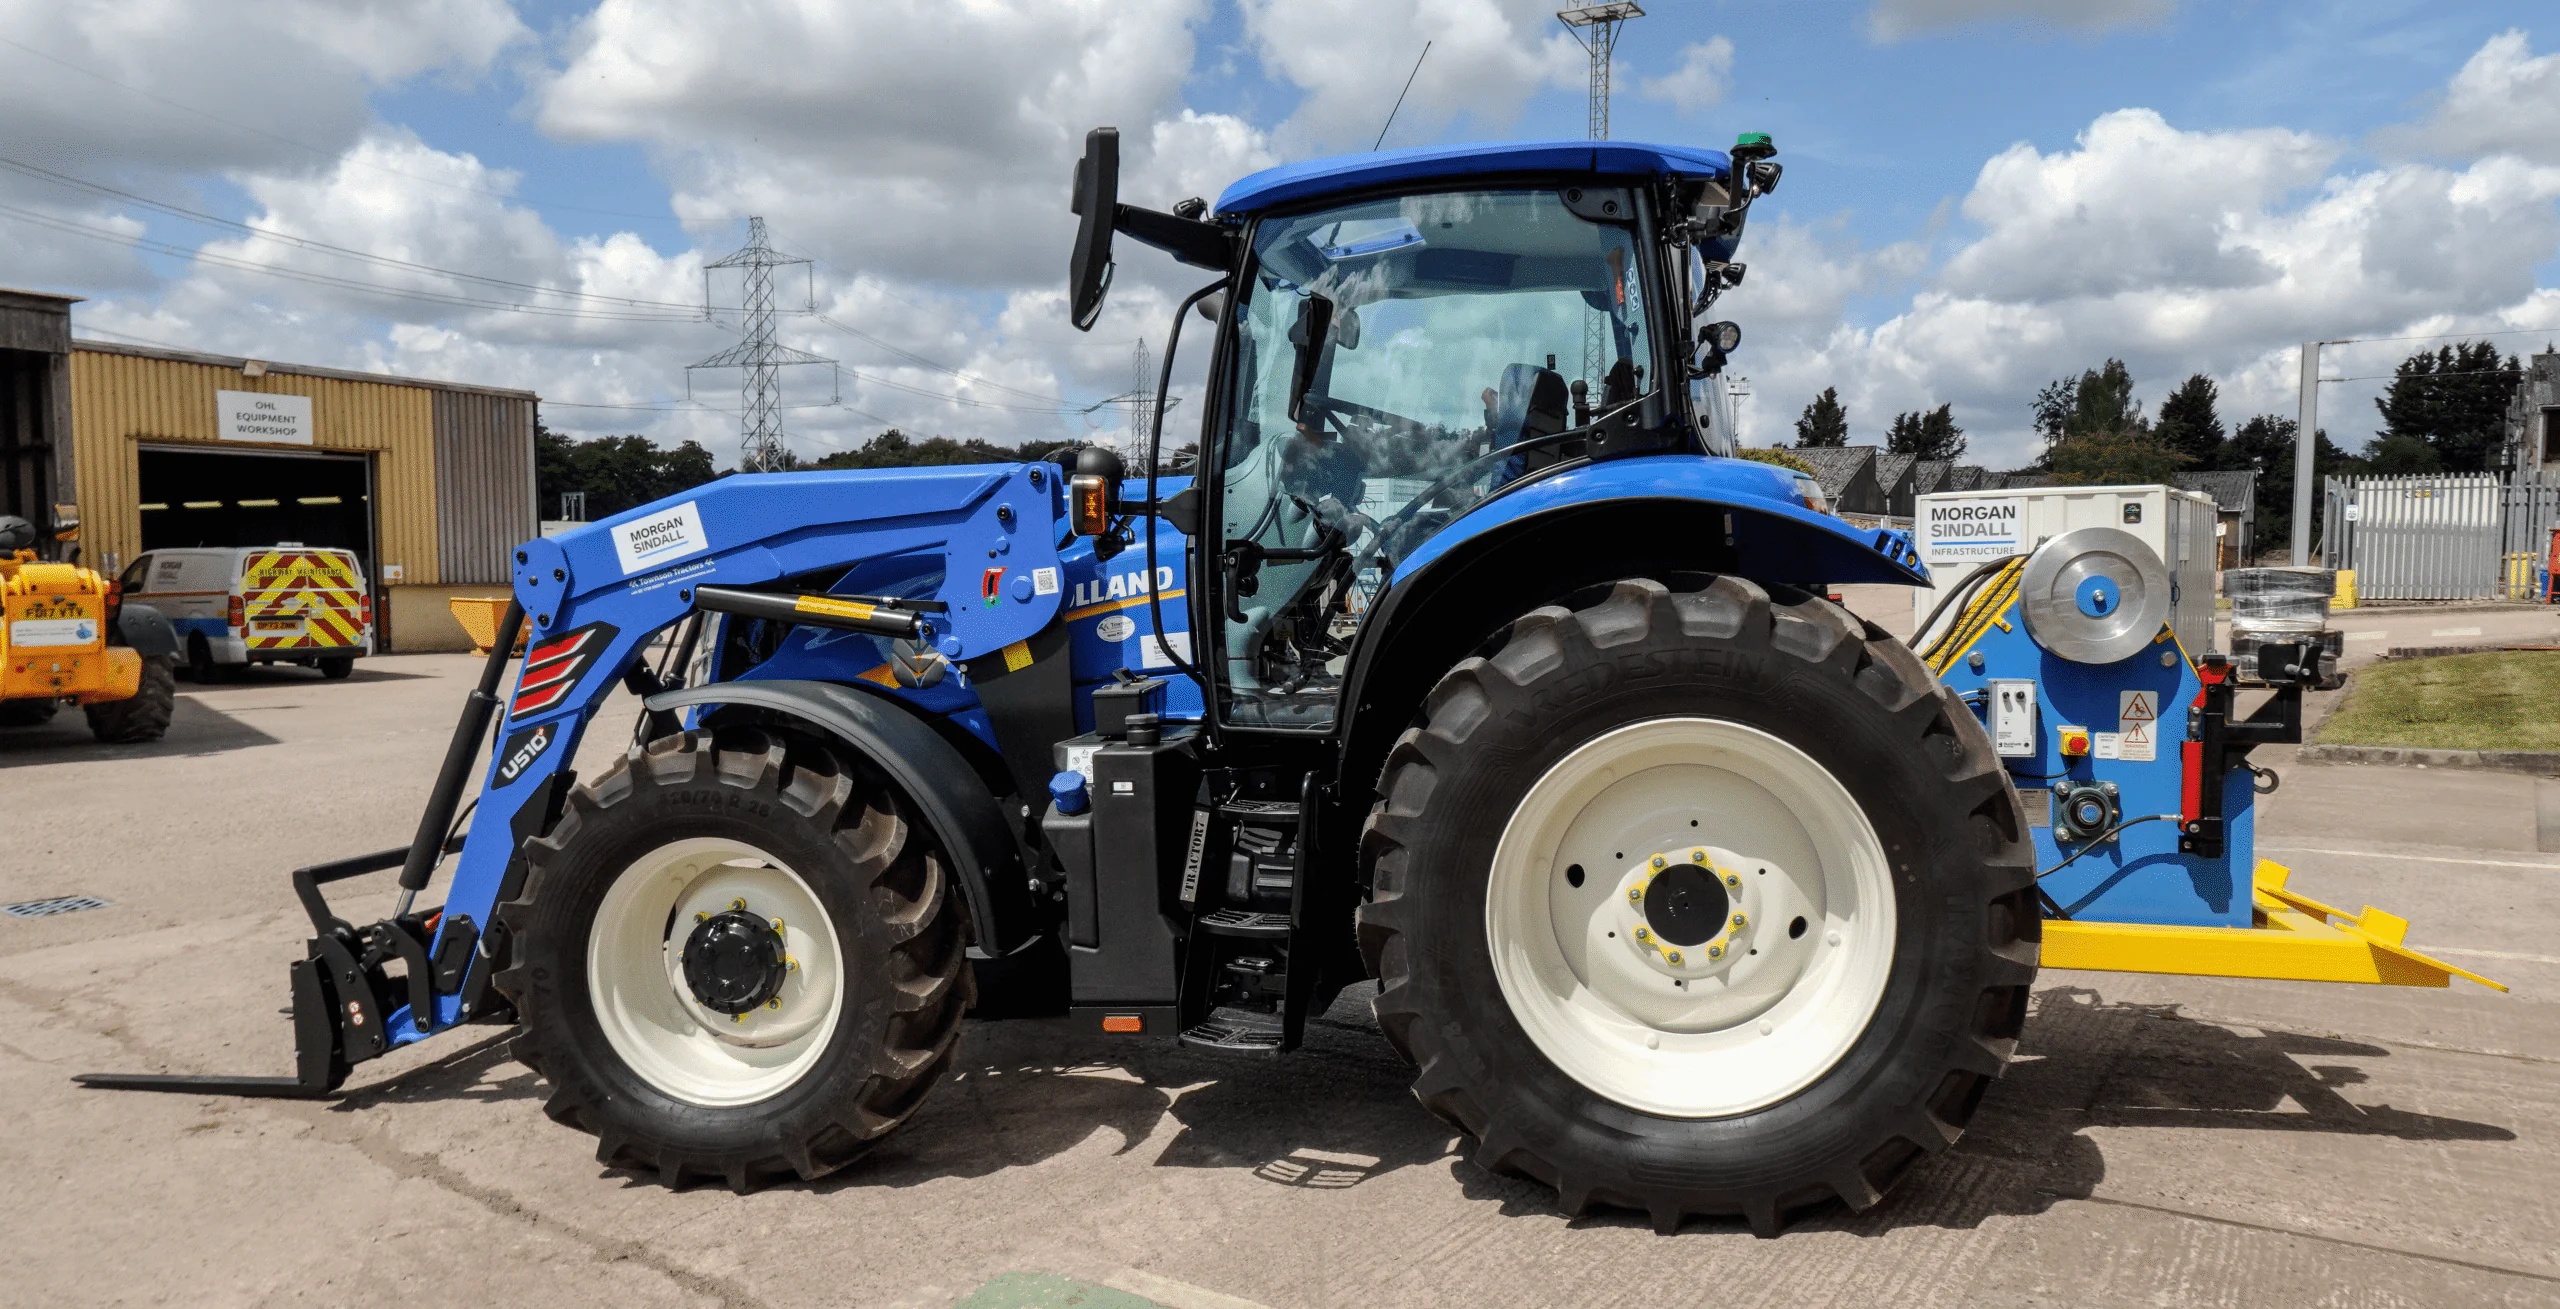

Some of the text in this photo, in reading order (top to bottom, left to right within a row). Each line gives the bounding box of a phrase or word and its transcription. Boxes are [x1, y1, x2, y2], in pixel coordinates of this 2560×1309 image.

[255, 401, 276, 411] OHL
[236, 412, 296, 424] EQUIPMENT
[237, 425, 297, 437] WORKSHOP
[1931, 505, 2016, 521] MORGAN
[629, 516, 684, 543] MORGAN
[1931, 522, 2012, 538] SINDALL
[633, 530, 685, 554] SINDALL
[1931, 546, 2015, 556] INFRASTRUCTURE
[639, 572, 673, 586] Townson
[673, 562, 704, 577] Tractors
[1069, 566, 1174, 608] LLAND
[1185, 821, 1205, 893] TRACTOR7
